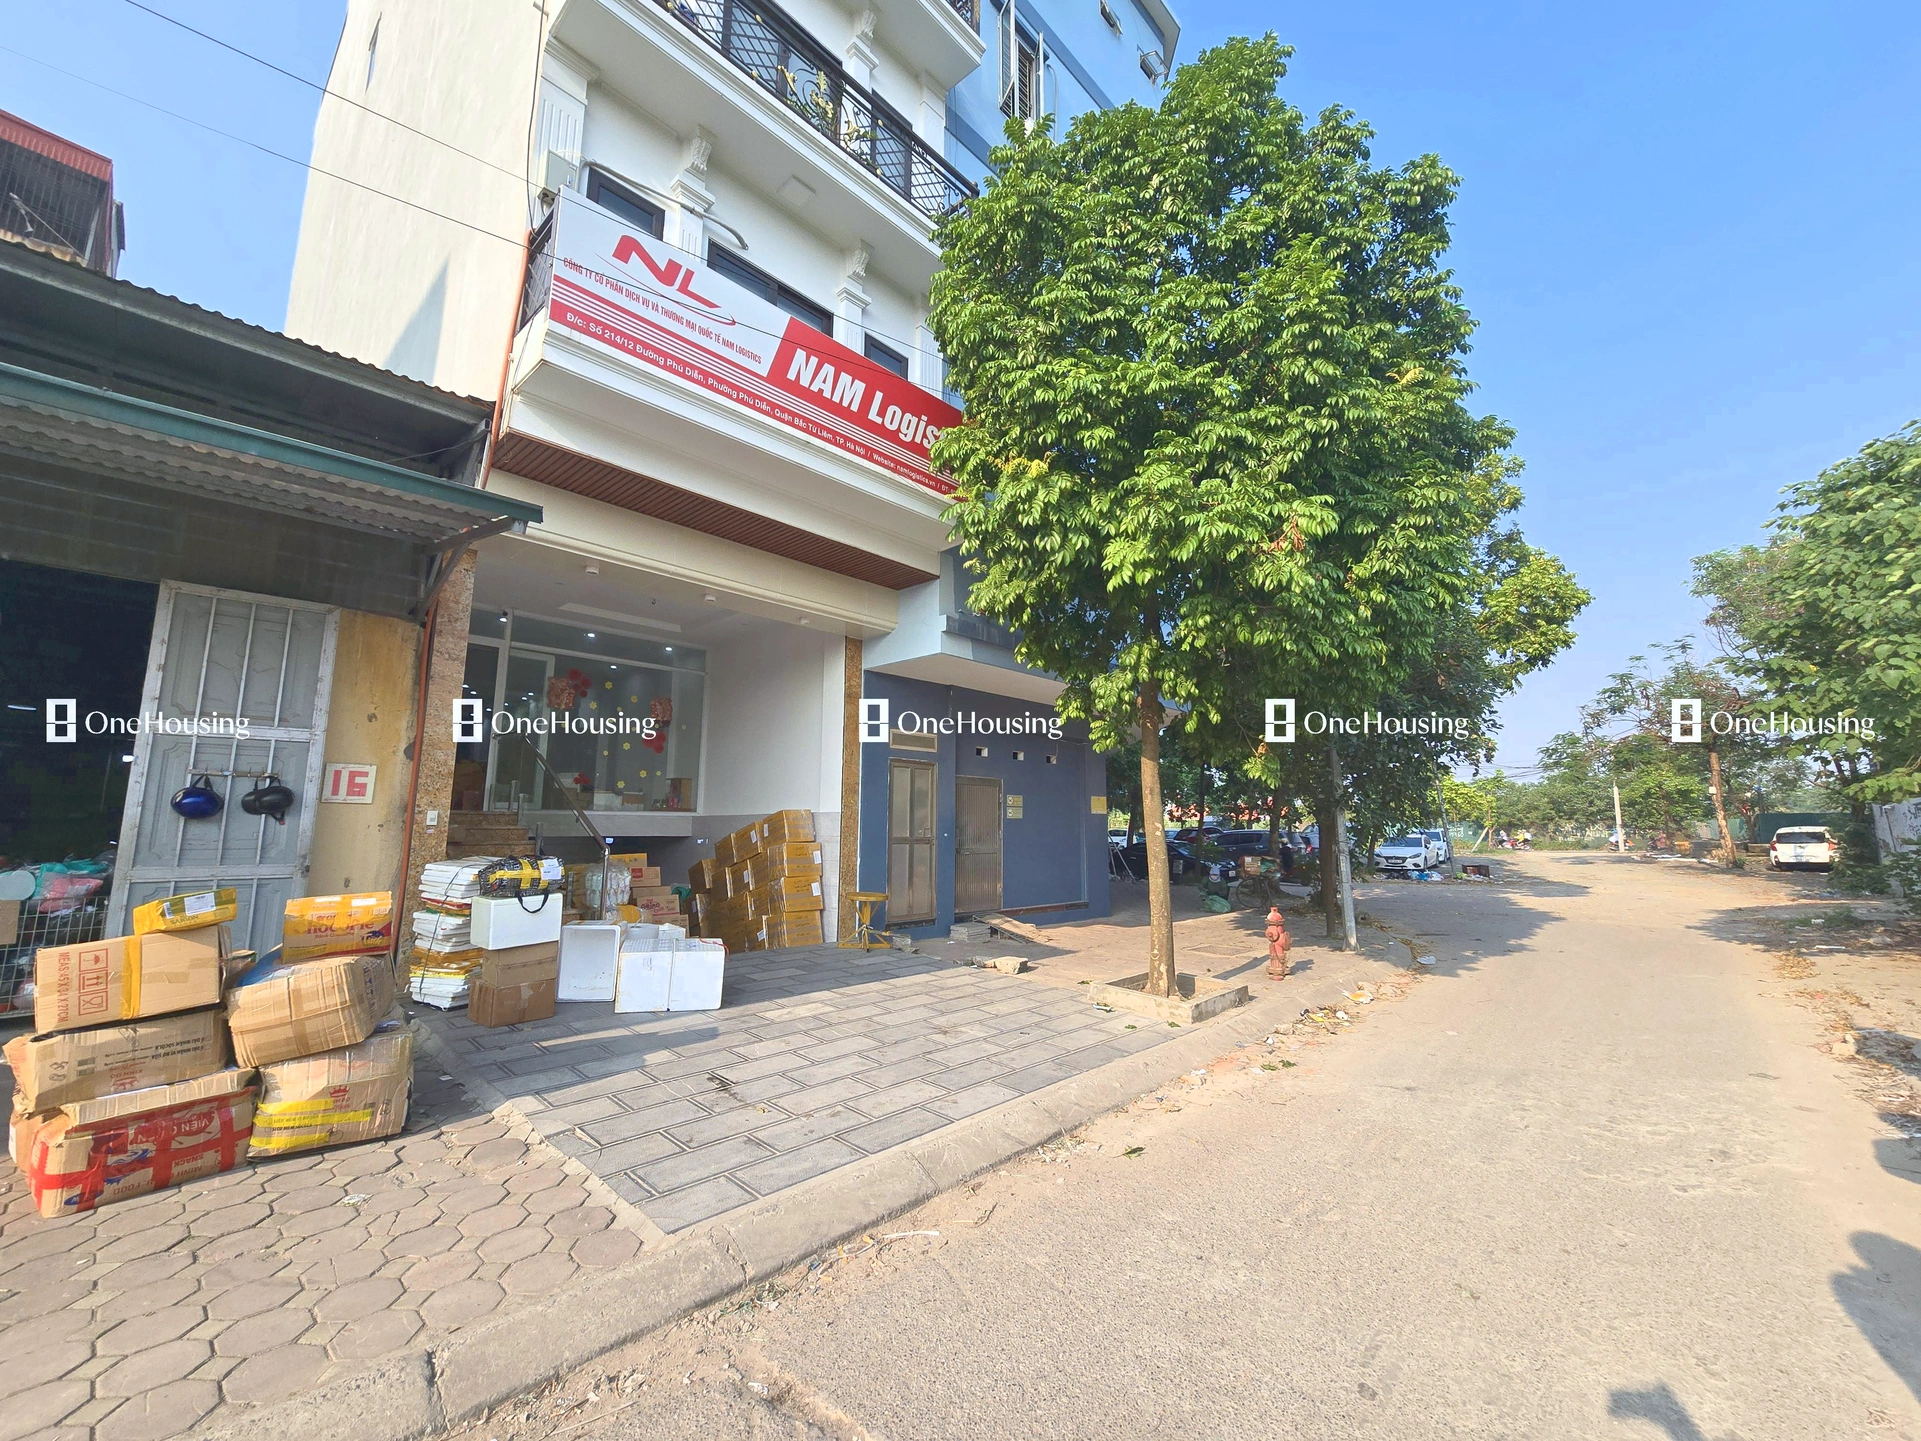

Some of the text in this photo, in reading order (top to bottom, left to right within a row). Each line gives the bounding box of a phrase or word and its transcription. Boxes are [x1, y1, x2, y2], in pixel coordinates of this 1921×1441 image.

[612, 235, 721, 309] NL
[563, 256, 762, 365] CÔNG TY CỔ PHẦN DỊCH VỤ VÀ THƯƠNG MẠI QUỐC TẾ NAM LOGISTICS
[566, 311, 587, 329] Đ/c:
[588, 322, 602, 336] Số
[604, 329, 635, 350] 214/12
[636, 345, 665, 366] Đường
[667, 358, 683, 373] Phú
[685, 366, 706, 385] Diễn,
[708, 377, 738, 400] Phường
[739, 391, 754, 405] Phú
[755, 398, 773, 415] Diễn,
[774, 407, 793, 423] Quận
[794, 416, 807, 429] Bắc
[818, 428, 835, 443] Liêm,
[846, 441, 855, 451] Hà
[855, 445, 866, 456] Nội
[873, 452, 896, 469] Website:
[786, 347, 946, 451] NAM Logis
[331, 769, 370, 797] 16
[113, 1182, 141, 1196] FOOD
[173, 1153, 204, 1168] SNACK
